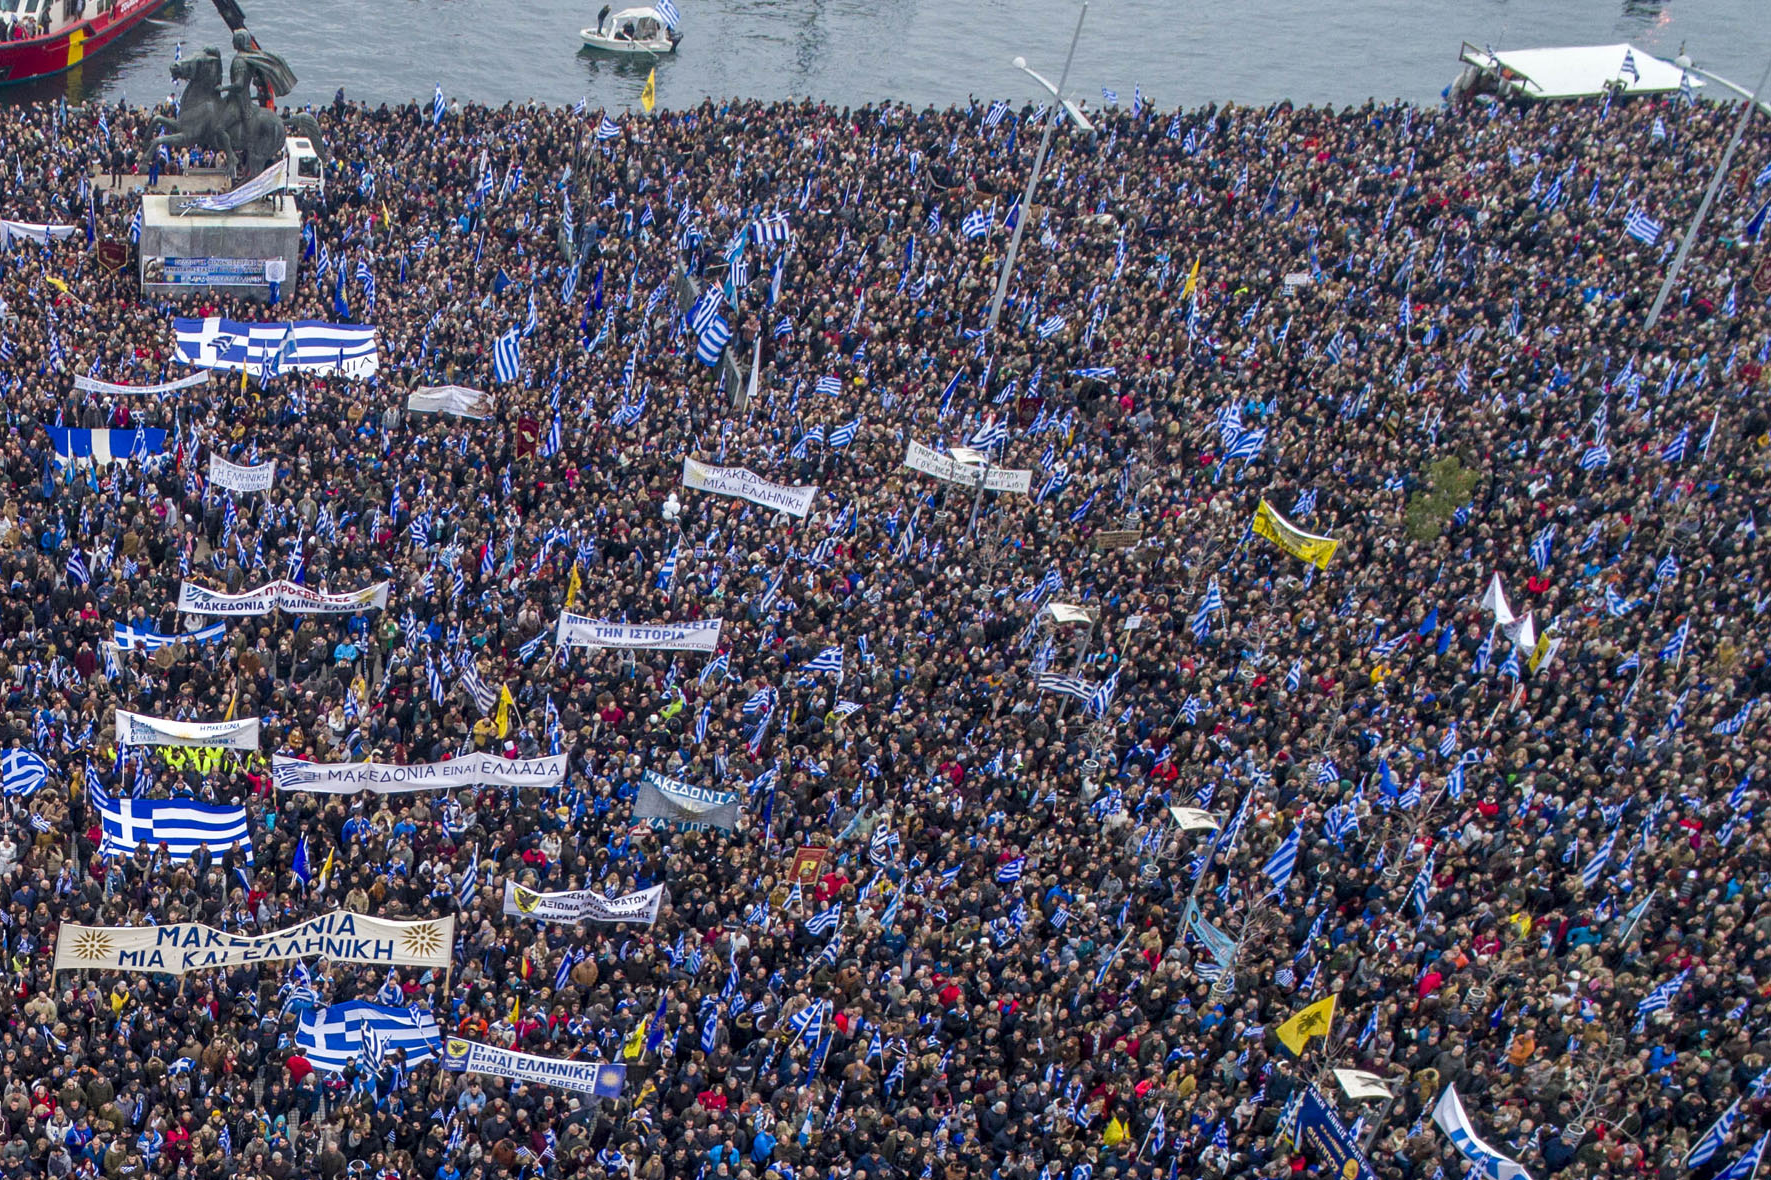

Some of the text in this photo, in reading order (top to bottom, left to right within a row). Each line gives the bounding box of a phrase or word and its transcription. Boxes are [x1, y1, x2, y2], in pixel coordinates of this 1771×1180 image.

[702, 478, 727, 490] ΜΙΑ
[741, 485, 805, 511] ΕΛΛΗΝΙΚΗ
[193, 600, 265, 611] ΜΑΚΕΔΟΝΙΑ
[595, 627, 686, 641] ΤΗΝ ΙΣΤΟΡΙΑ
[328, 764, 437, 784] ΜΑΚΕΔΟΝΙΑ
[442, 763, 476, 777] ΕΙΝΑΙ
[480, 760, 561, 777] ΕΛΛΑΔΑ
[644, 770, 738, 805] ΜΑΚΕΔΟΝΙΑ
[118, 950, 165, 968] ΜΙΑ
[242, 935, 395, 961] ΕΛΛΗΝΙΚΗ
[472, 1051, 512, 1069] ΕΙΝΑΙ
[516, 1058, 597, 1082] ΕΛΛΗΝΙΚΗ
[549, 1078, 593, 1093] GREECE
